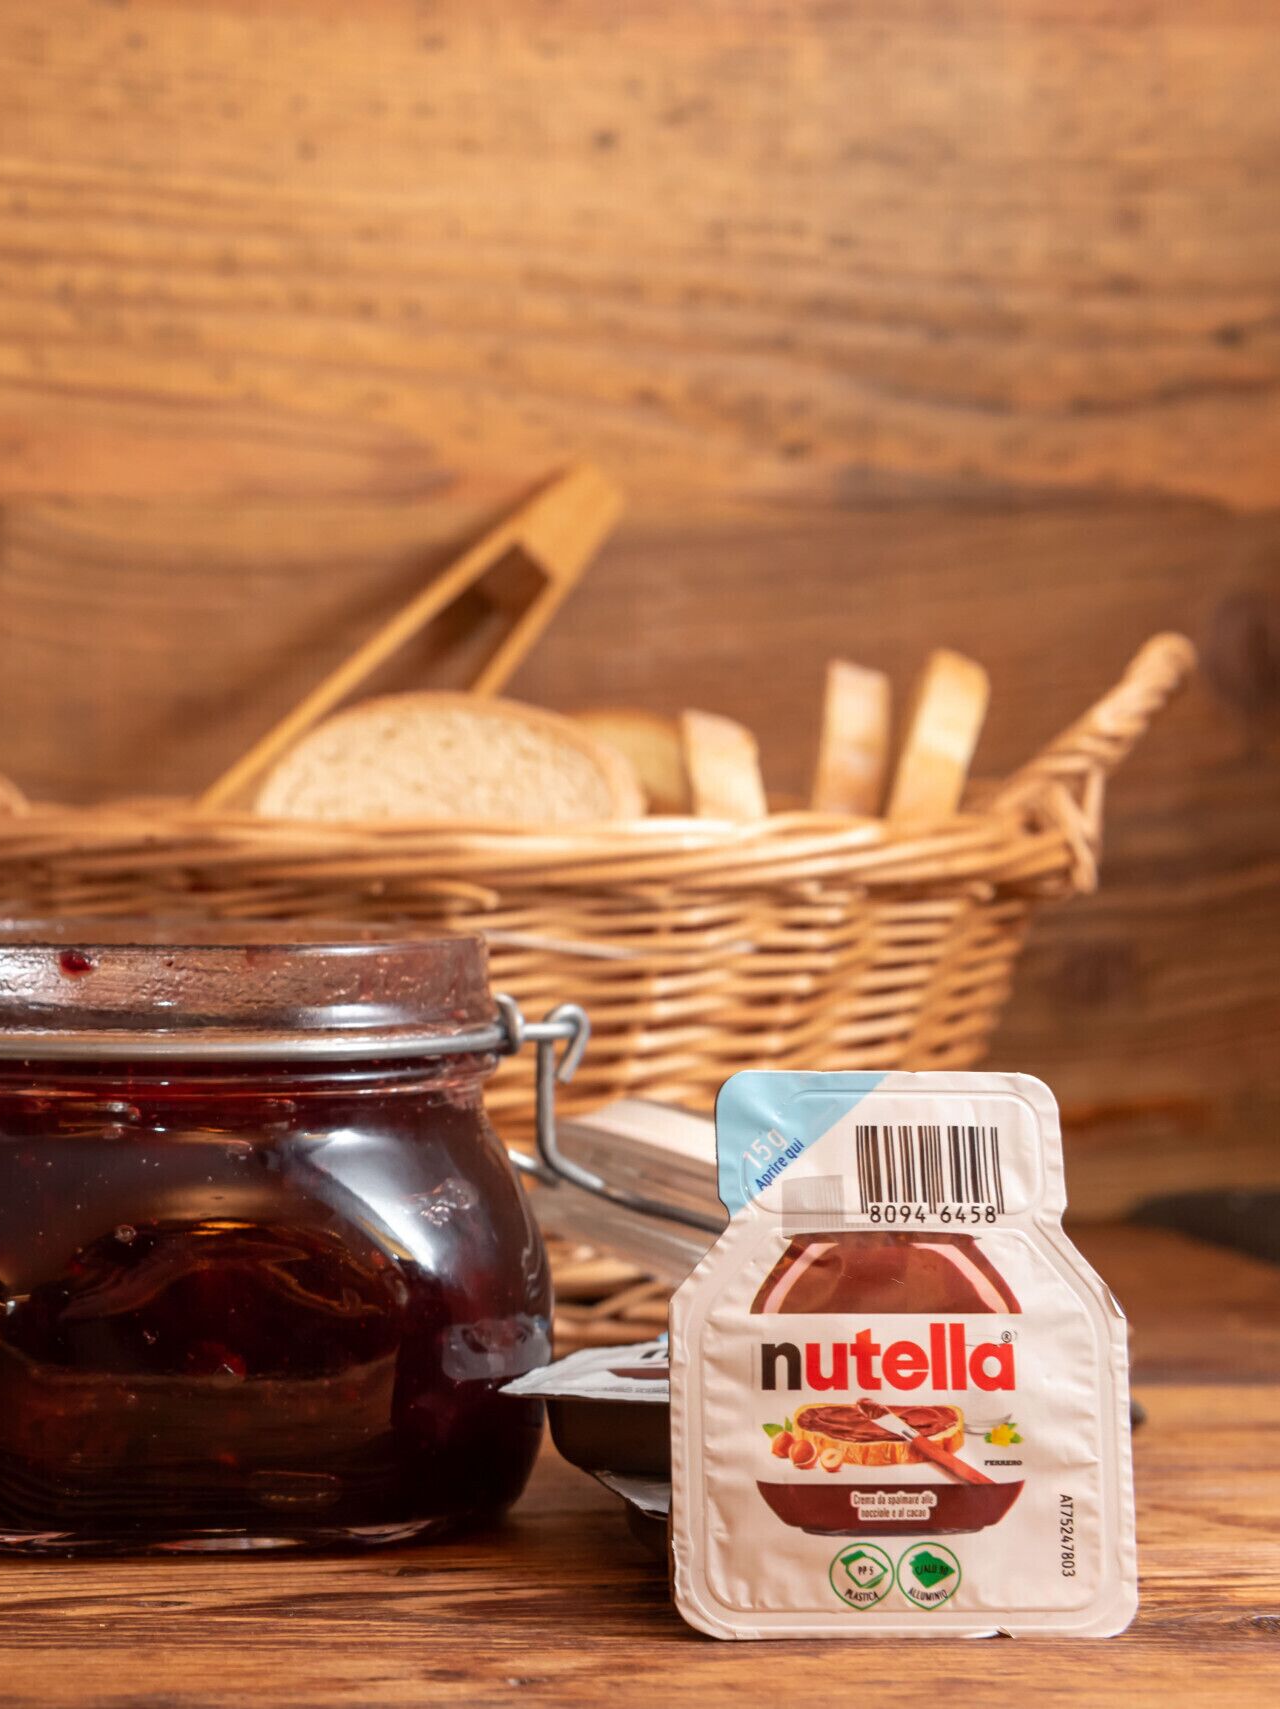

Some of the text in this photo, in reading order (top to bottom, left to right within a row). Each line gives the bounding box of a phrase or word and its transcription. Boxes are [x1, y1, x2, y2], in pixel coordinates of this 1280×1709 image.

[743, 1128, 788, 1169] 15 g
[755, 1137, 806, 1191] Aprire qui
[870, 1205, 996, 1223] 8094 6458
[761, 1323, 1016, 1391] nutella
[853, 1494, 876, 1504] Crema
[878, 1494, 886, 1504] da
[888, 1494, 919, 1506] spalmare
[1060, 1493, 1076, 1577] AT75247803
[844, 1588, 880, 1602] PLASTICA
[908, 1587, 949, 1601] ALLUMINIO
